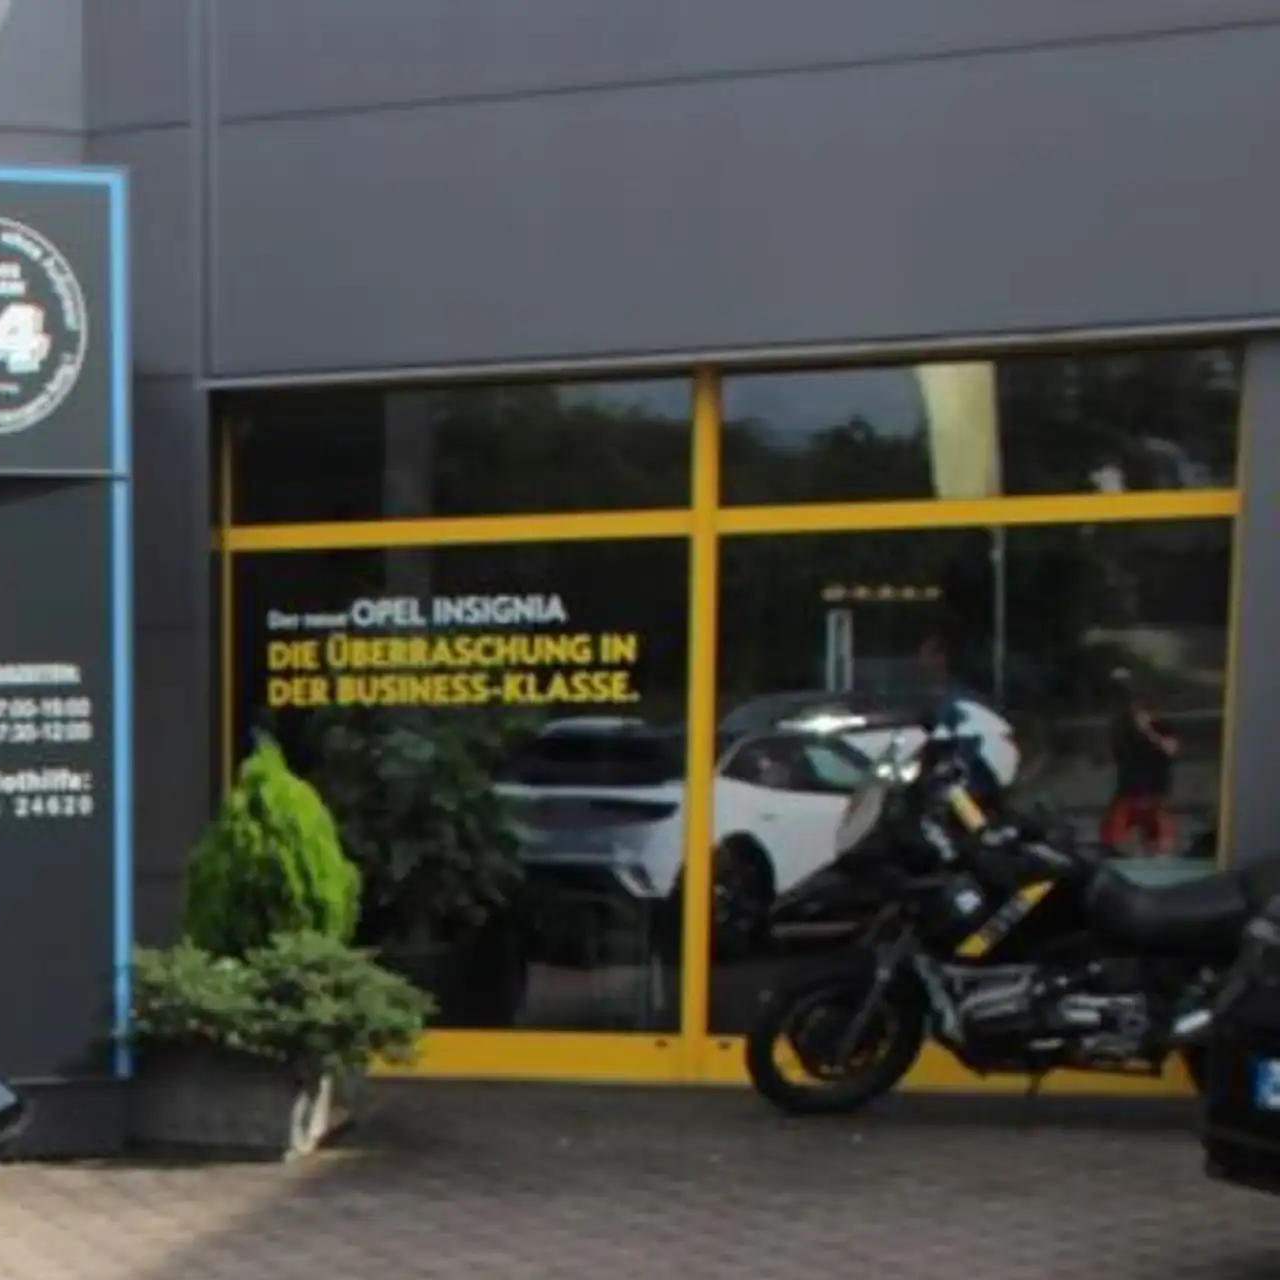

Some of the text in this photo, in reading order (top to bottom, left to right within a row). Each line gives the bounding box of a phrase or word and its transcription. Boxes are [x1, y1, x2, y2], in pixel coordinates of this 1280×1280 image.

[351, 598, 426, 627] OPEL
[267, 630, 638, 671] DIE ÜBERRASCHUNG IN
[267, 670, 641, 707] DER BUSINESS-KLASSE.
